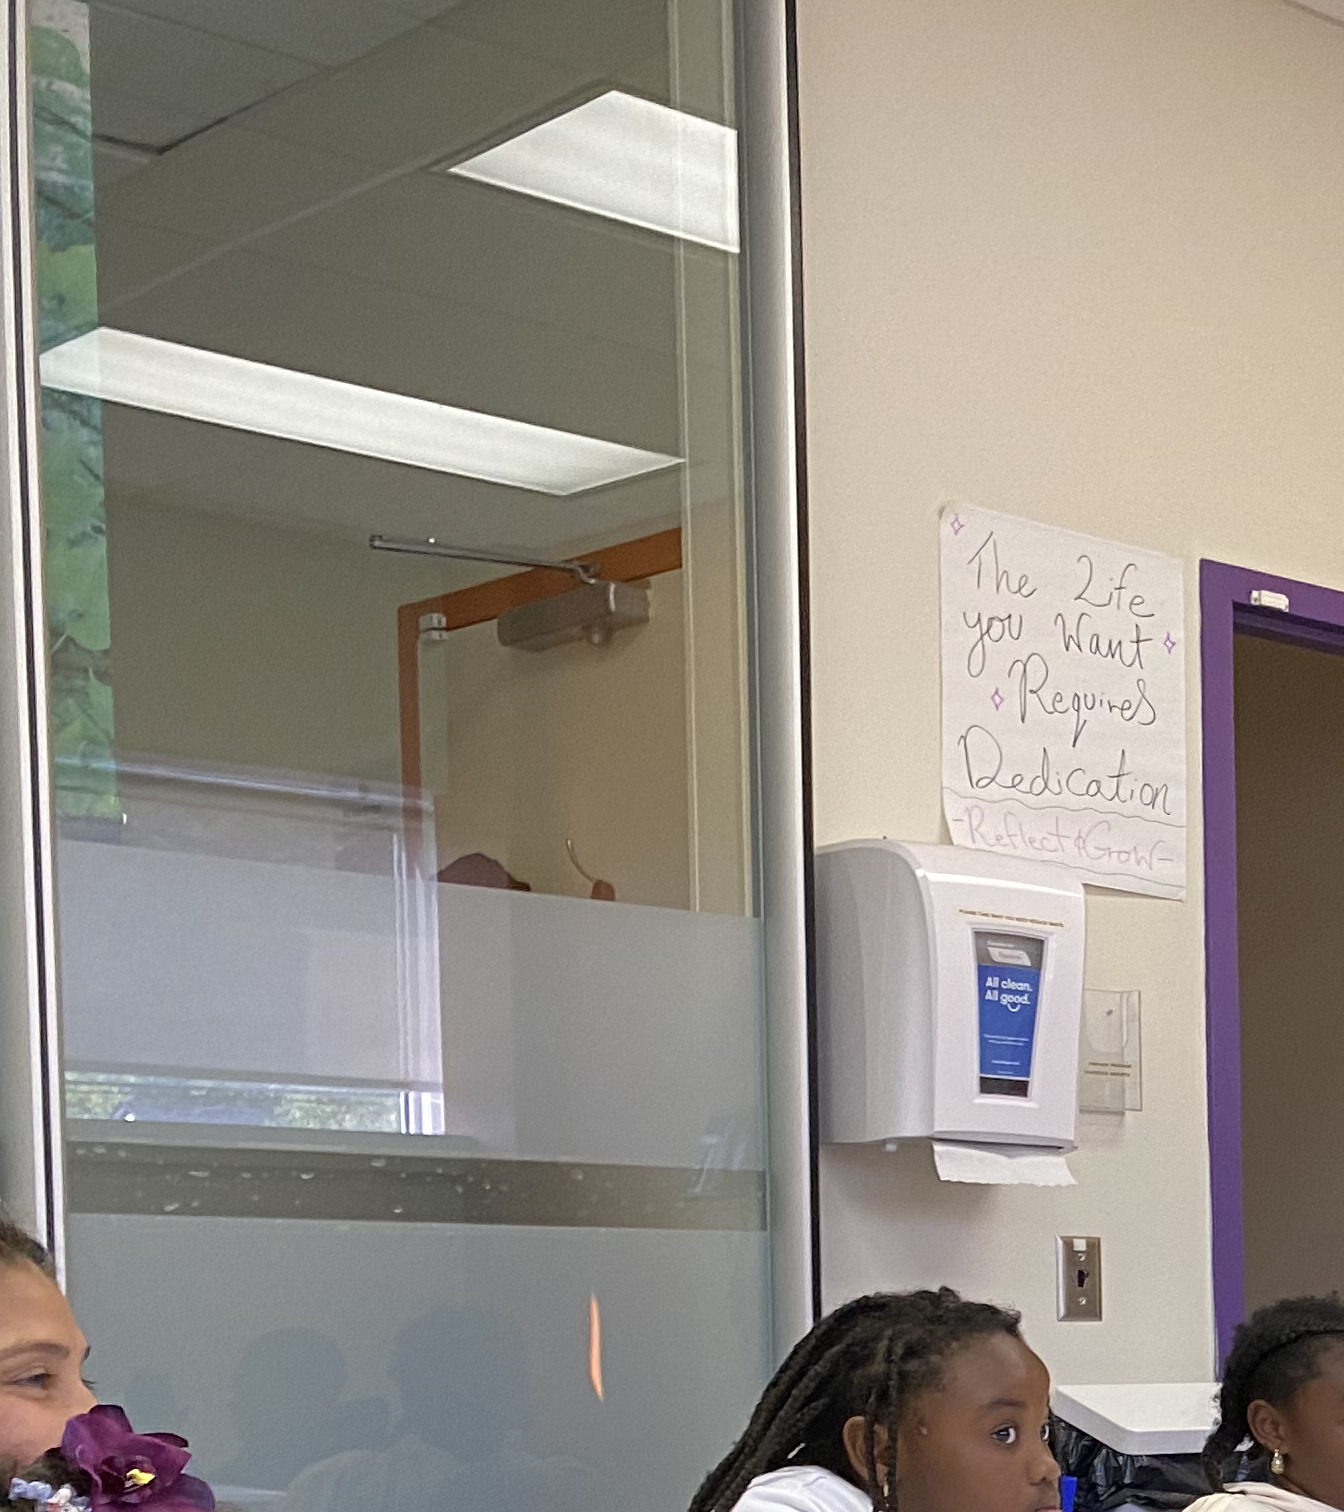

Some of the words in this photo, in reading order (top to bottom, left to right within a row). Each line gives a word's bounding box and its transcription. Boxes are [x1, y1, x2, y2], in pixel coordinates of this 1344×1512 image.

[968, 532, 1037, 599] The
[963, 611, 1025, 678] you
[1054, 613, 1153, 670] Want
[1008, 653, 1156, 748] Requires
[958, 724, 1171, 816] Dedication
[984, 989, 999, 1001] All
[1000, 991, 1031, 1006] good.
[985, 976, 1000, 988] All
[1001, 978, 1033, 992] clean.
